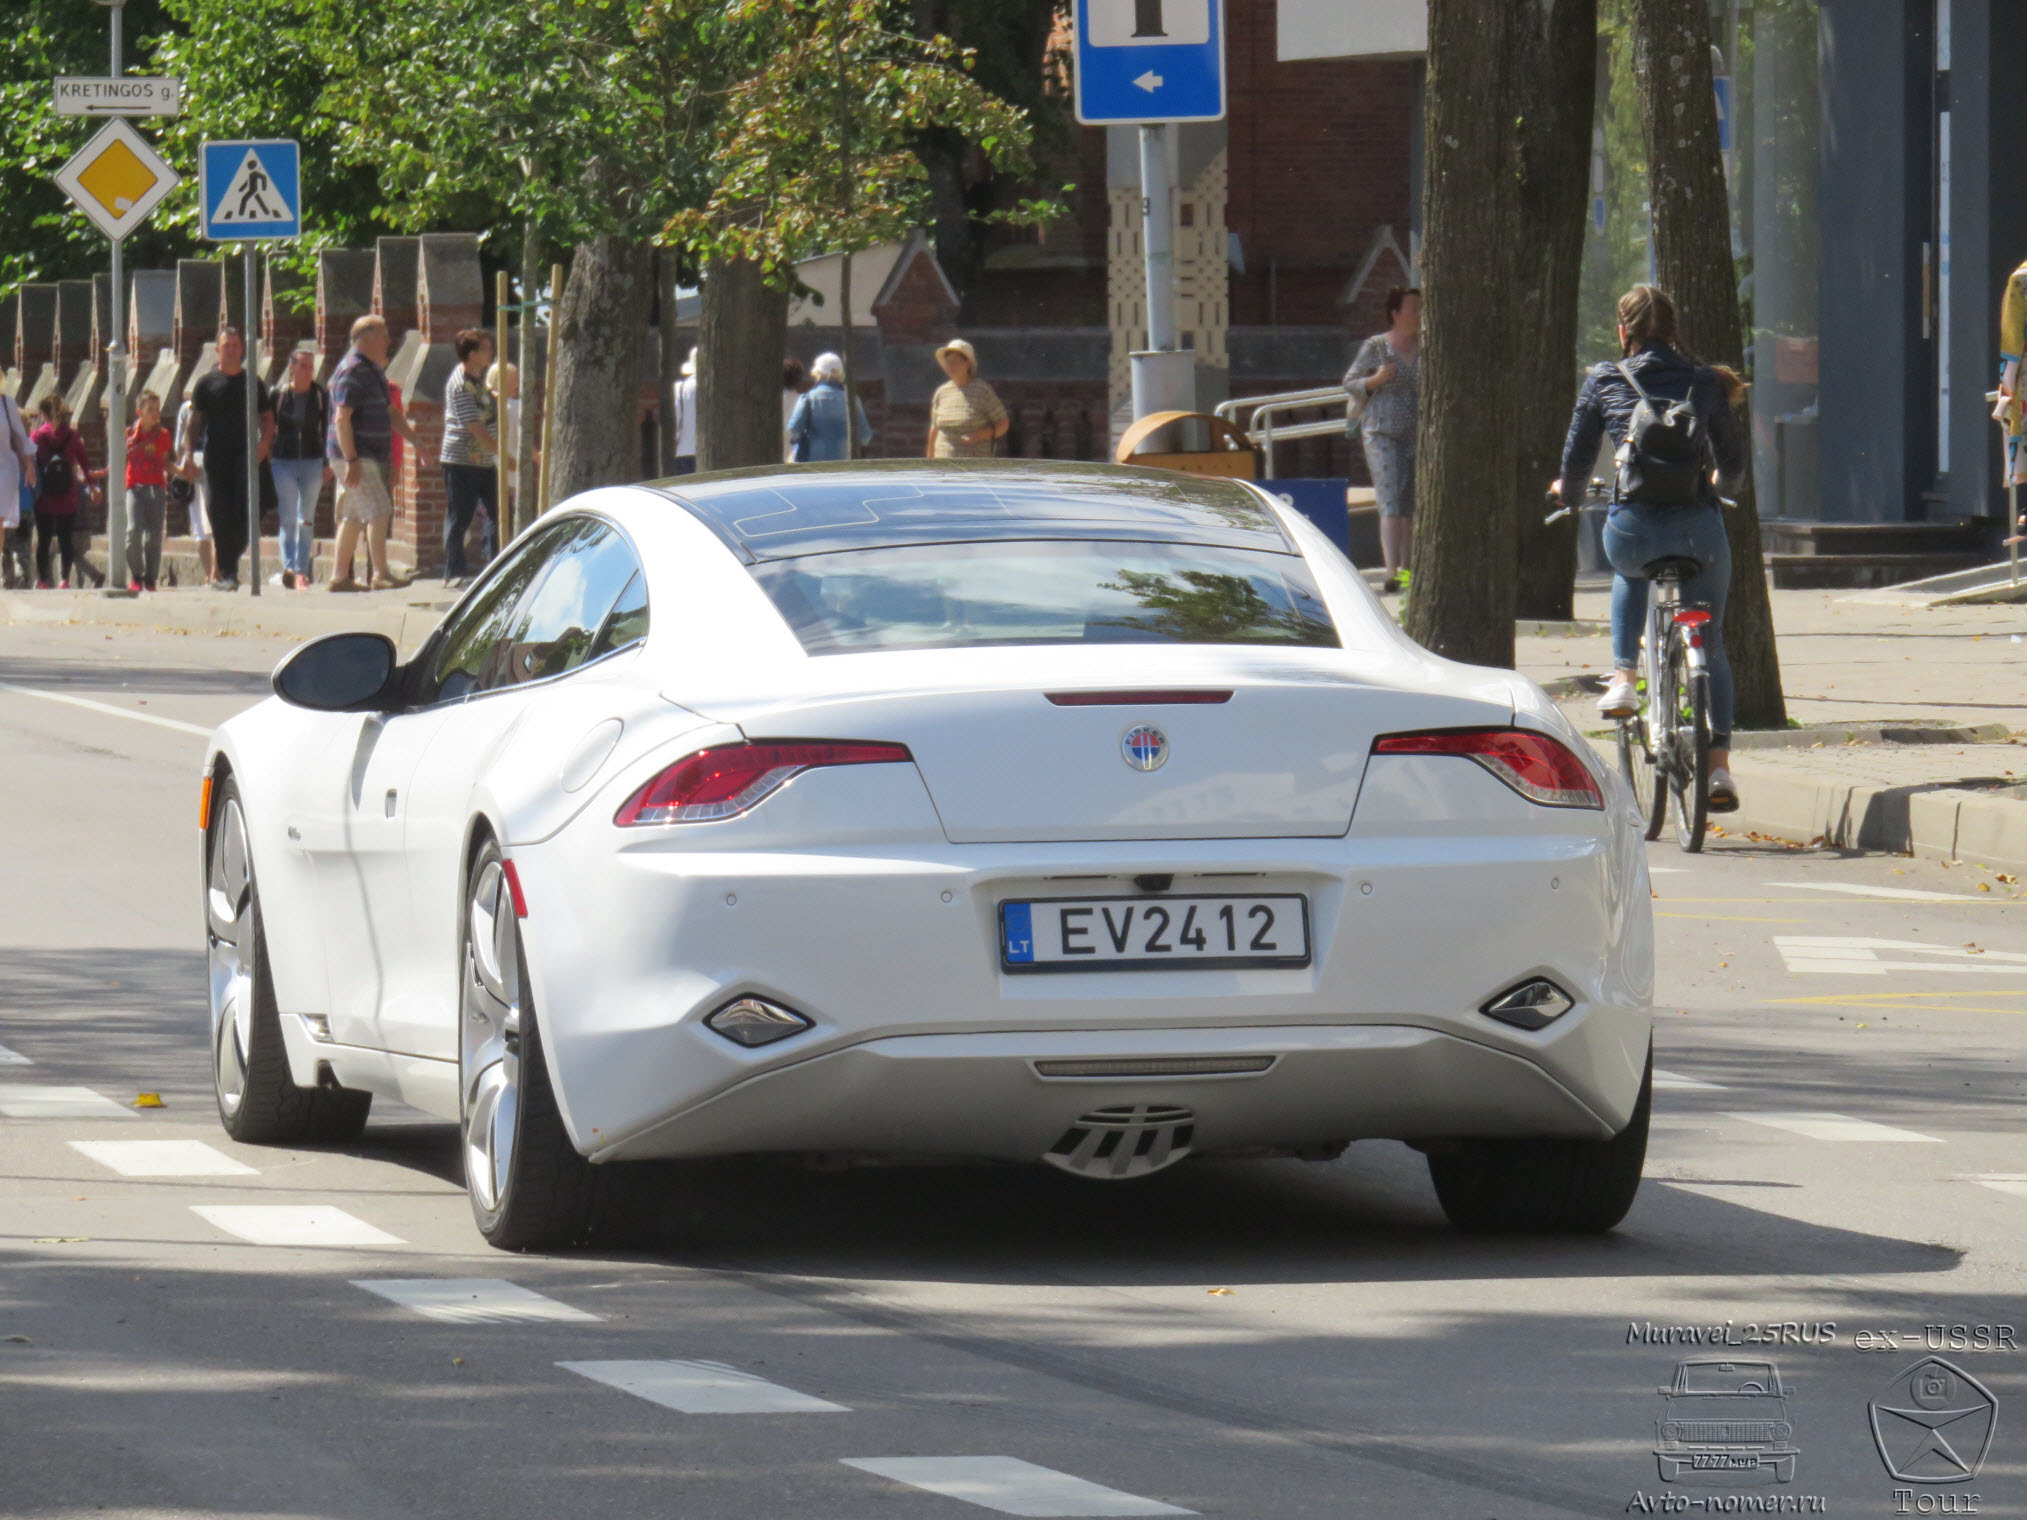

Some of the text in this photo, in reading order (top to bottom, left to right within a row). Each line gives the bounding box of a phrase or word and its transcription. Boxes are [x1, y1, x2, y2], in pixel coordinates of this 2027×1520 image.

[60, 83, 174, 100] KRETINGOS g.
[1125, 727, 1165, 745] FISKER
[1060, 904, 1277, 954] EV2412
[1009, 939, 1030, 954] LT
